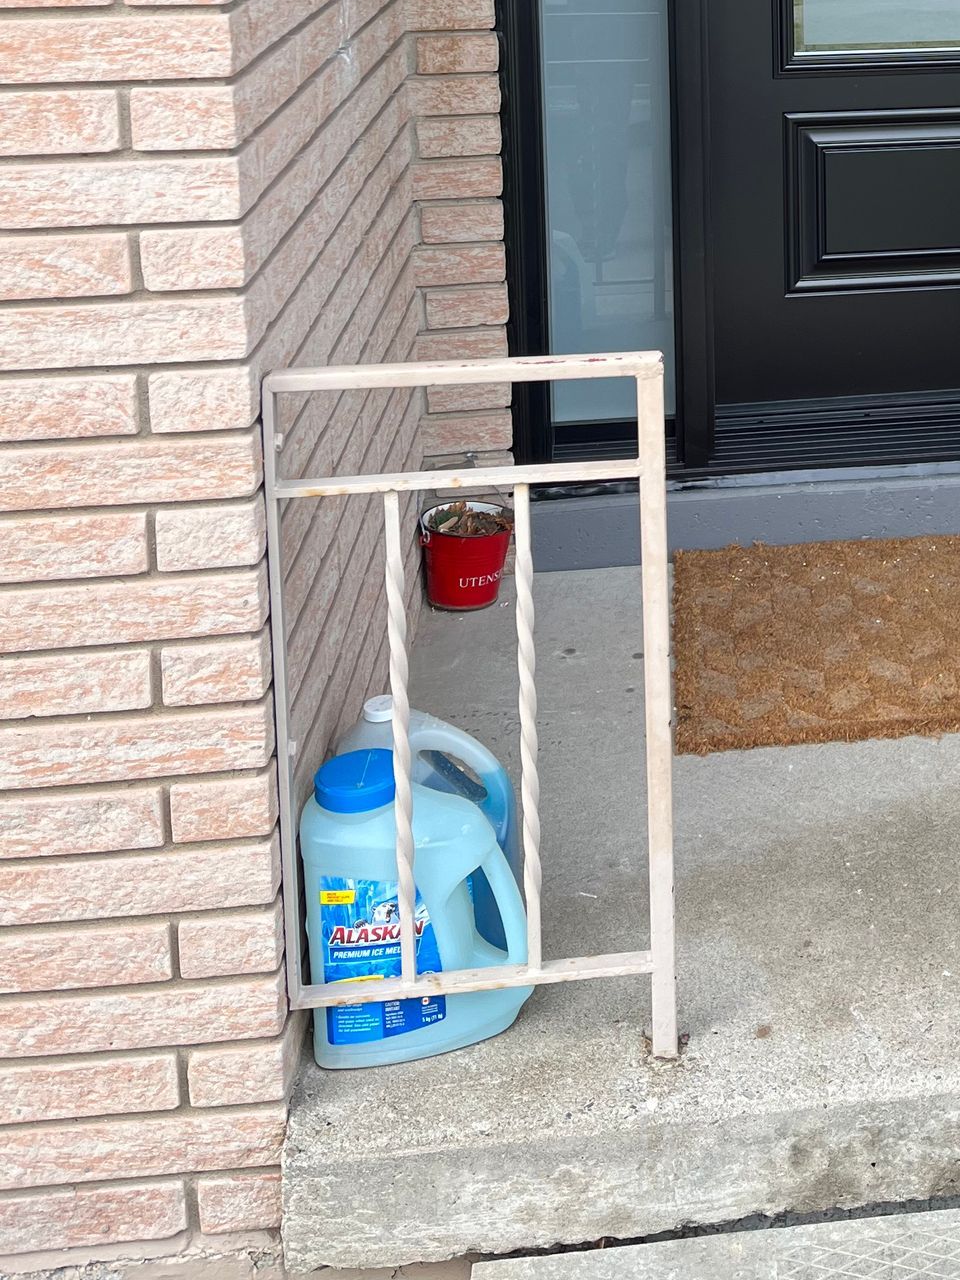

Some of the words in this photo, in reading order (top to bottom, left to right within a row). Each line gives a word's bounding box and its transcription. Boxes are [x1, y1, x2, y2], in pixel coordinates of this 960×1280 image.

[333, 948, 370, 959] PREMIUM
[371, 947, 383, 957] ICE
[385, 946, 402, 955] MEL
